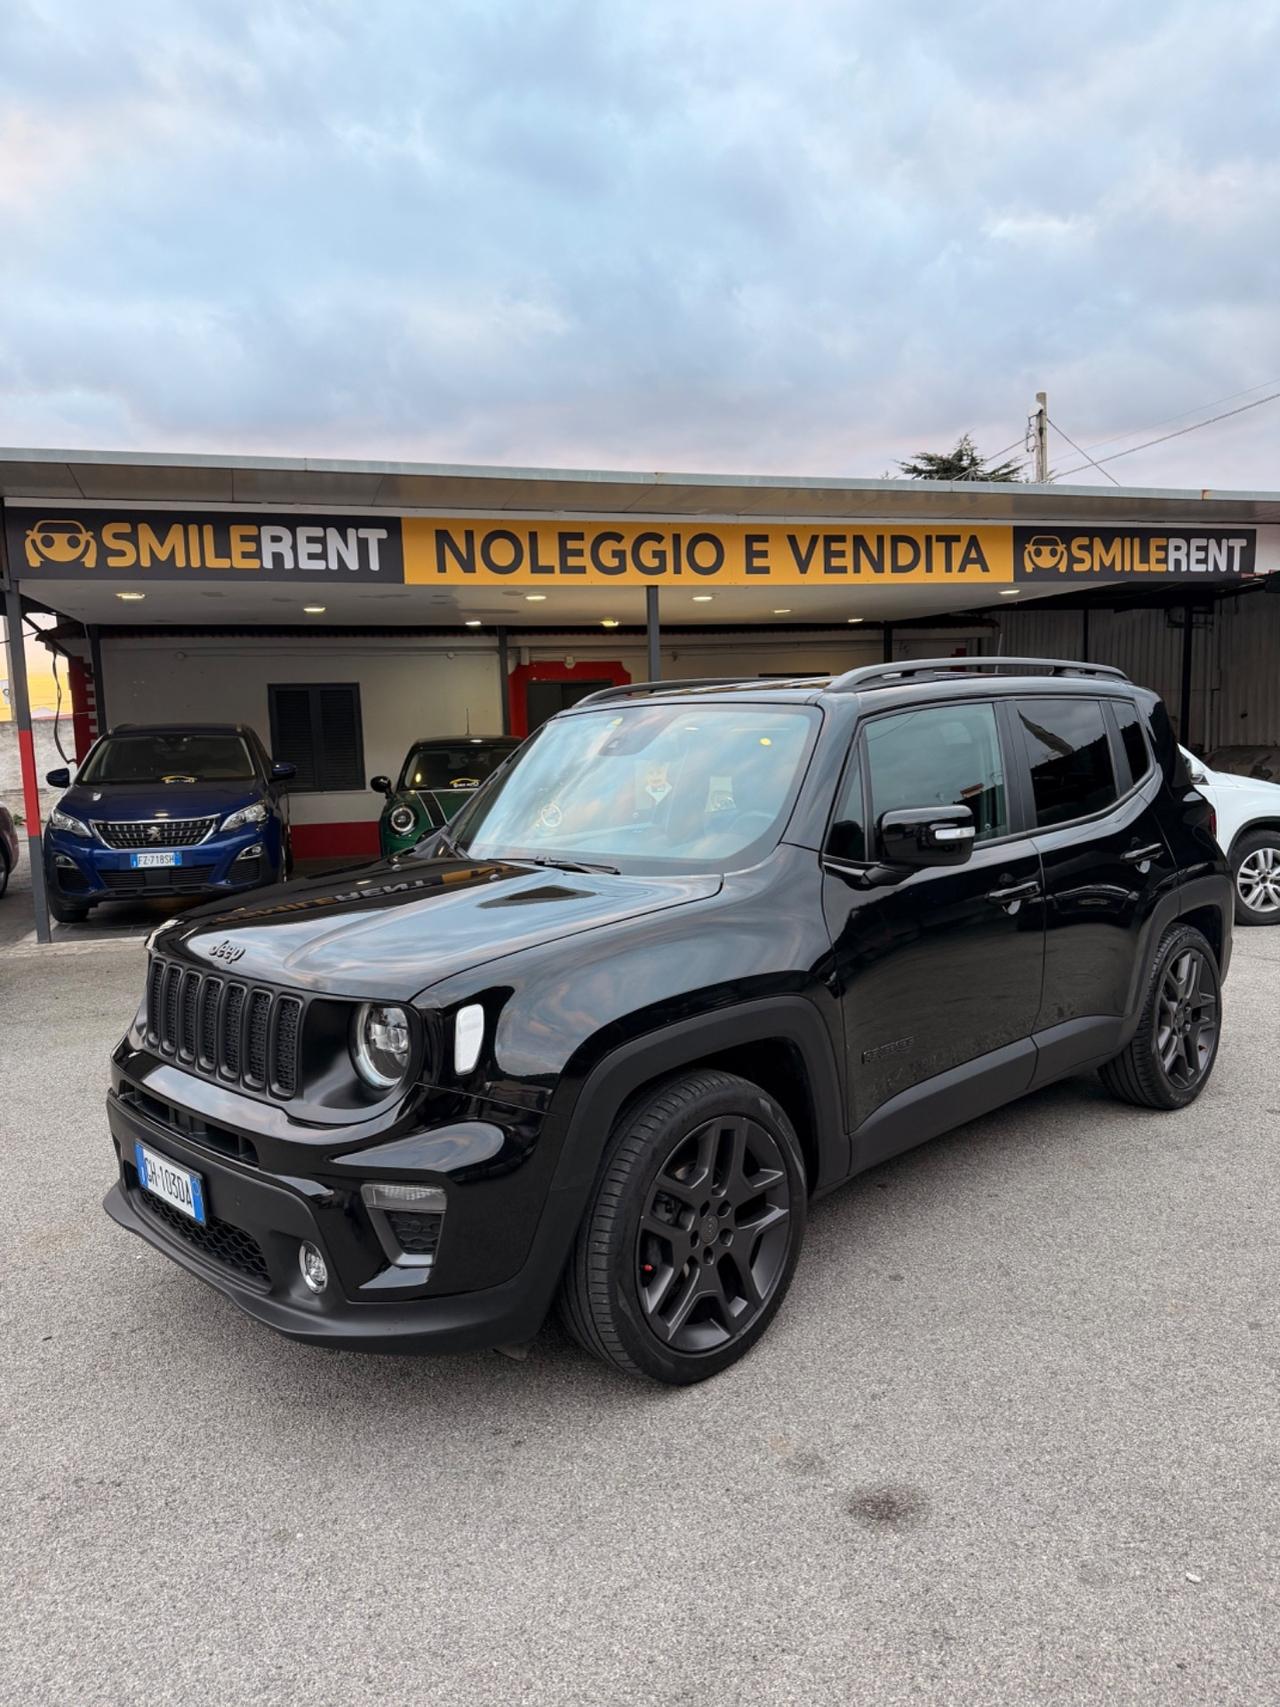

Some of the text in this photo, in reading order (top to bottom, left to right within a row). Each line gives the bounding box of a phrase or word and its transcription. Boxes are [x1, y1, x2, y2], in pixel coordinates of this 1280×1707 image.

[101, 522, 388, 571] SMILERENT
[434, 529, 990, 576] NOLEGGIO E VENDITA
[1072, 536, 1248, 573] SMILERENT
[208, 939, 246, 965] Jeep
